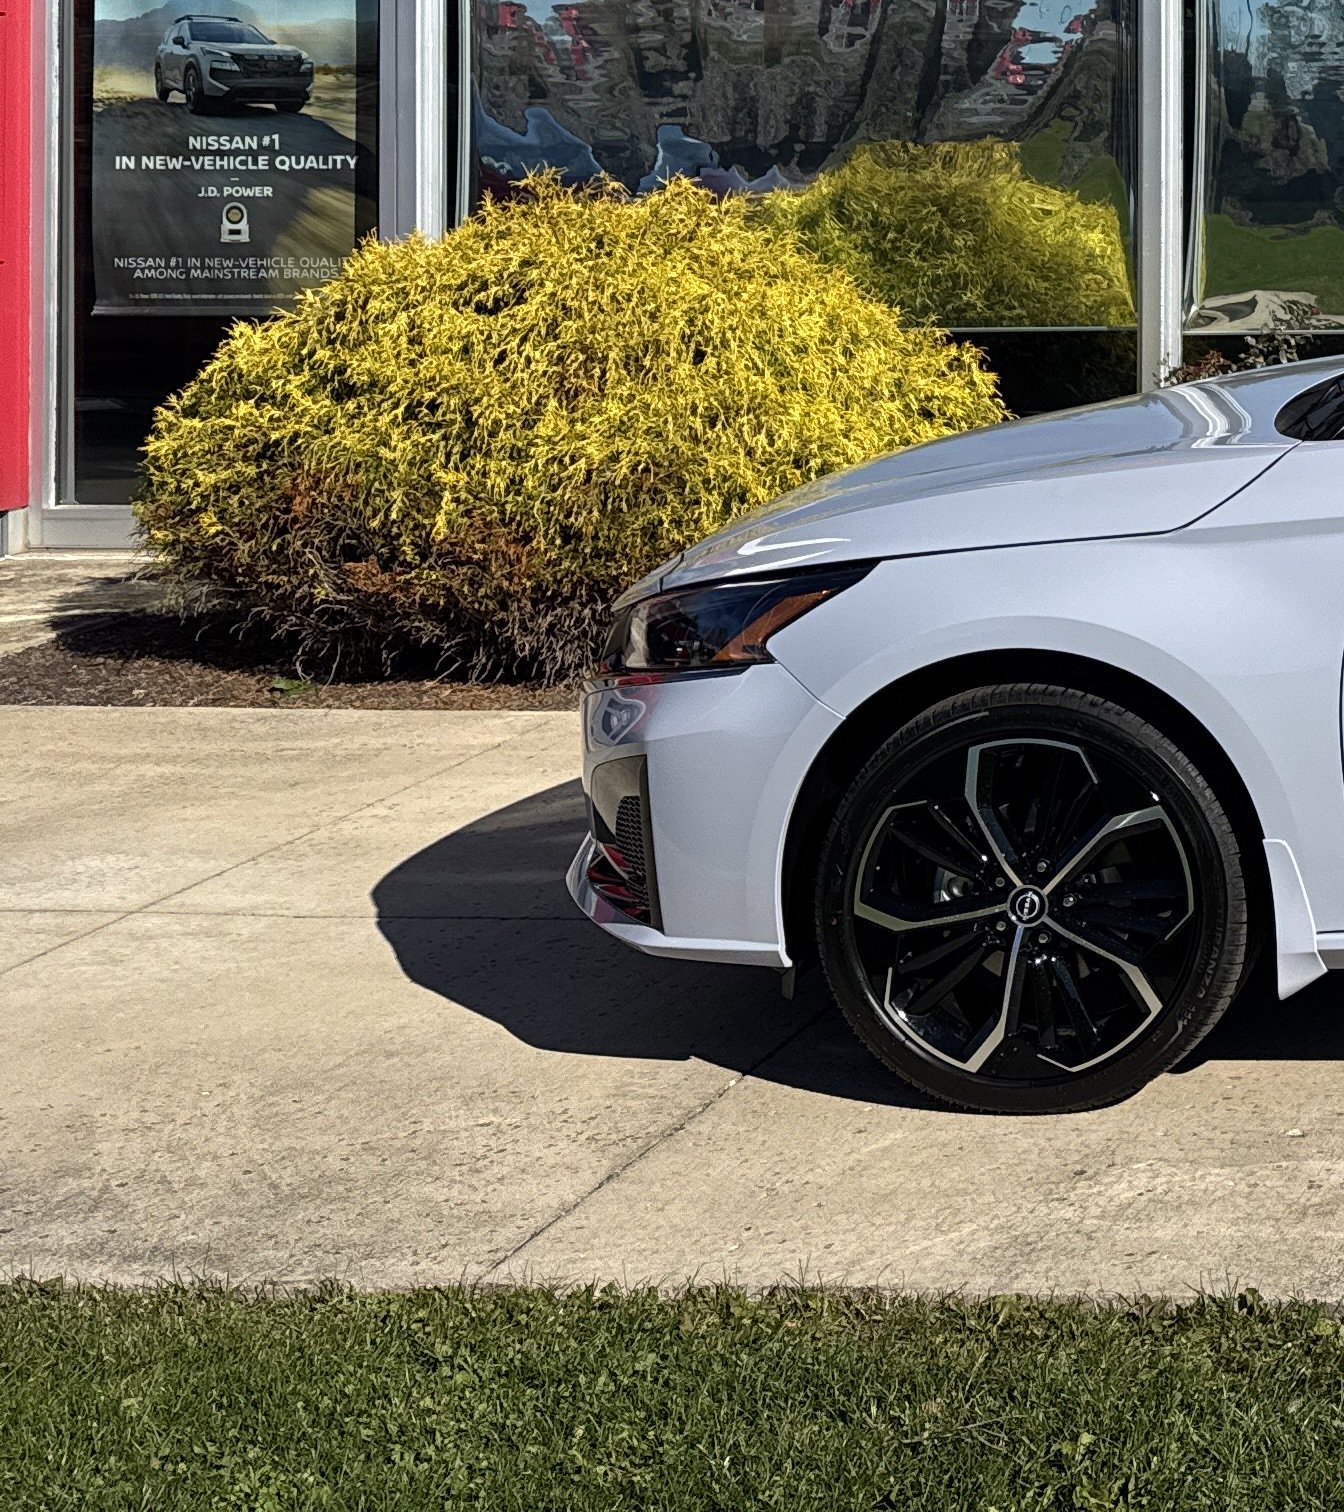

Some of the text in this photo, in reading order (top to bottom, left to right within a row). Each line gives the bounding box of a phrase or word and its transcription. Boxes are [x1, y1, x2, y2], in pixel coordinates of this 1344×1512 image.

[188, 133, 280, 150] NISSAN #1
[115, 155, 359, 171] IN NEW-VEHICLE QUALITY
[197, 186, 273, 198] J.D. POWER
[113, 257, 165, 268] NISSAN
[169, 257, 183, 268] #1
[187, 257, 201, 268] IN
[204, 257, 295, 268] NEW-VEHICLE
[133, 268, 339, 279] AMONG MAINSTREAM BRANDS
